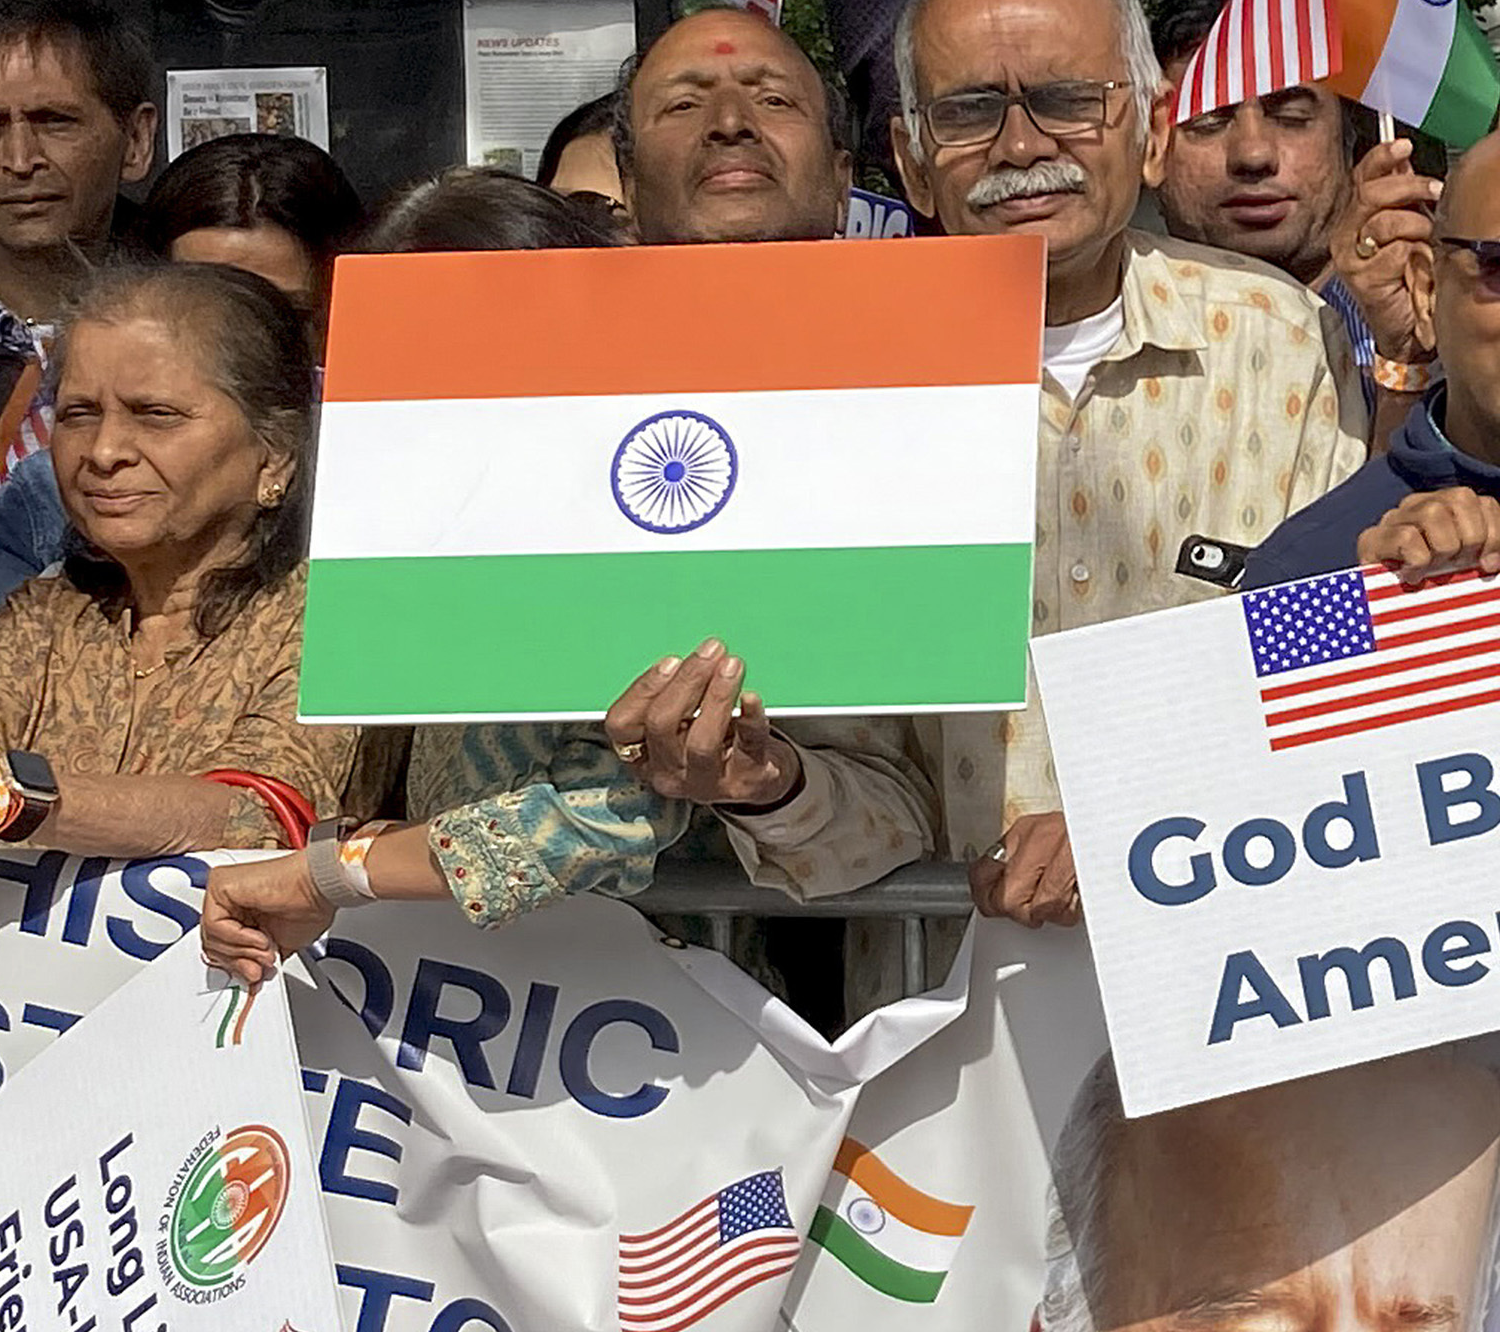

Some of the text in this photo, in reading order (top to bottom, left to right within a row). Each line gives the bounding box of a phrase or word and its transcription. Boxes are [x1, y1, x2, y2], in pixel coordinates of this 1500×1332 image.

[1127, 771, 1381, 907] God
[99, 1132, 145, 1297] Long
[156, 1124, 247, 1304] FEDERATION OF INDIAN ASSOCIATIONS
